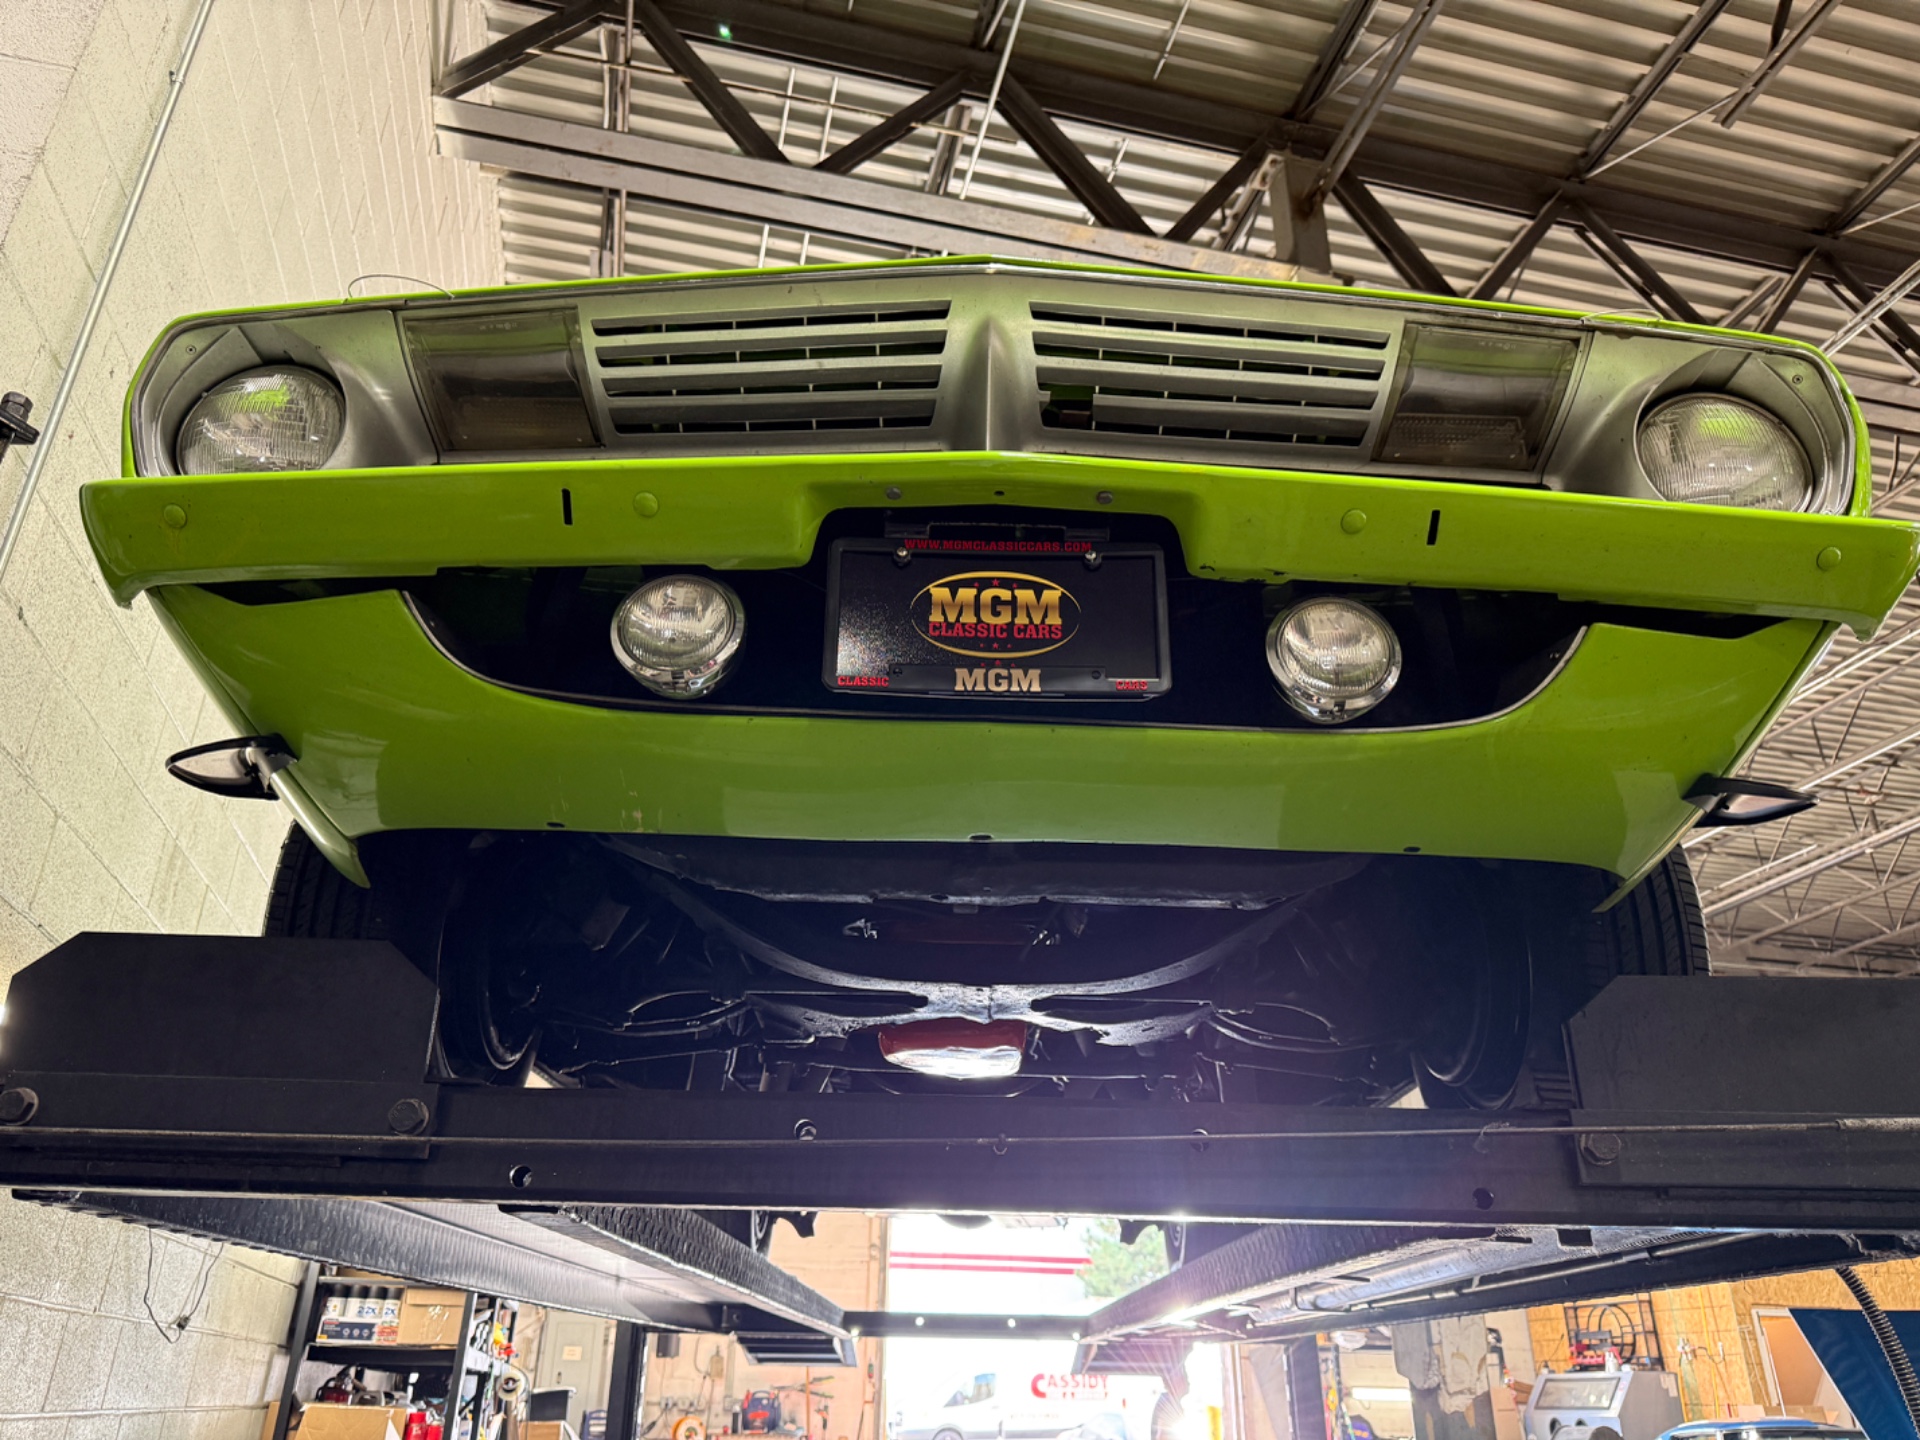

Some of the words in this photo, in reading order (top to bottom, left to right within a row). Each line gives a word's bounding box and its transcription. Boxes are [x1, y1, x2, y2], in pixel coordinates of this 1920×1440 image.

[904, 539, 1092, 552] WWW.MGMCLASSICCARS.COM
[928, 587, 1062, 625] MGM
[928, 621, 1007, 638] CLASSIC
[1013, 624, 1062, 639] CARS
[837, 675, 889, 687] CLASSIC
[1115, 680, 1148, 690] CARS
[954, 667, 1041, 692] MGM
[1030, 1373, 1108, 1398] CASSIDY
